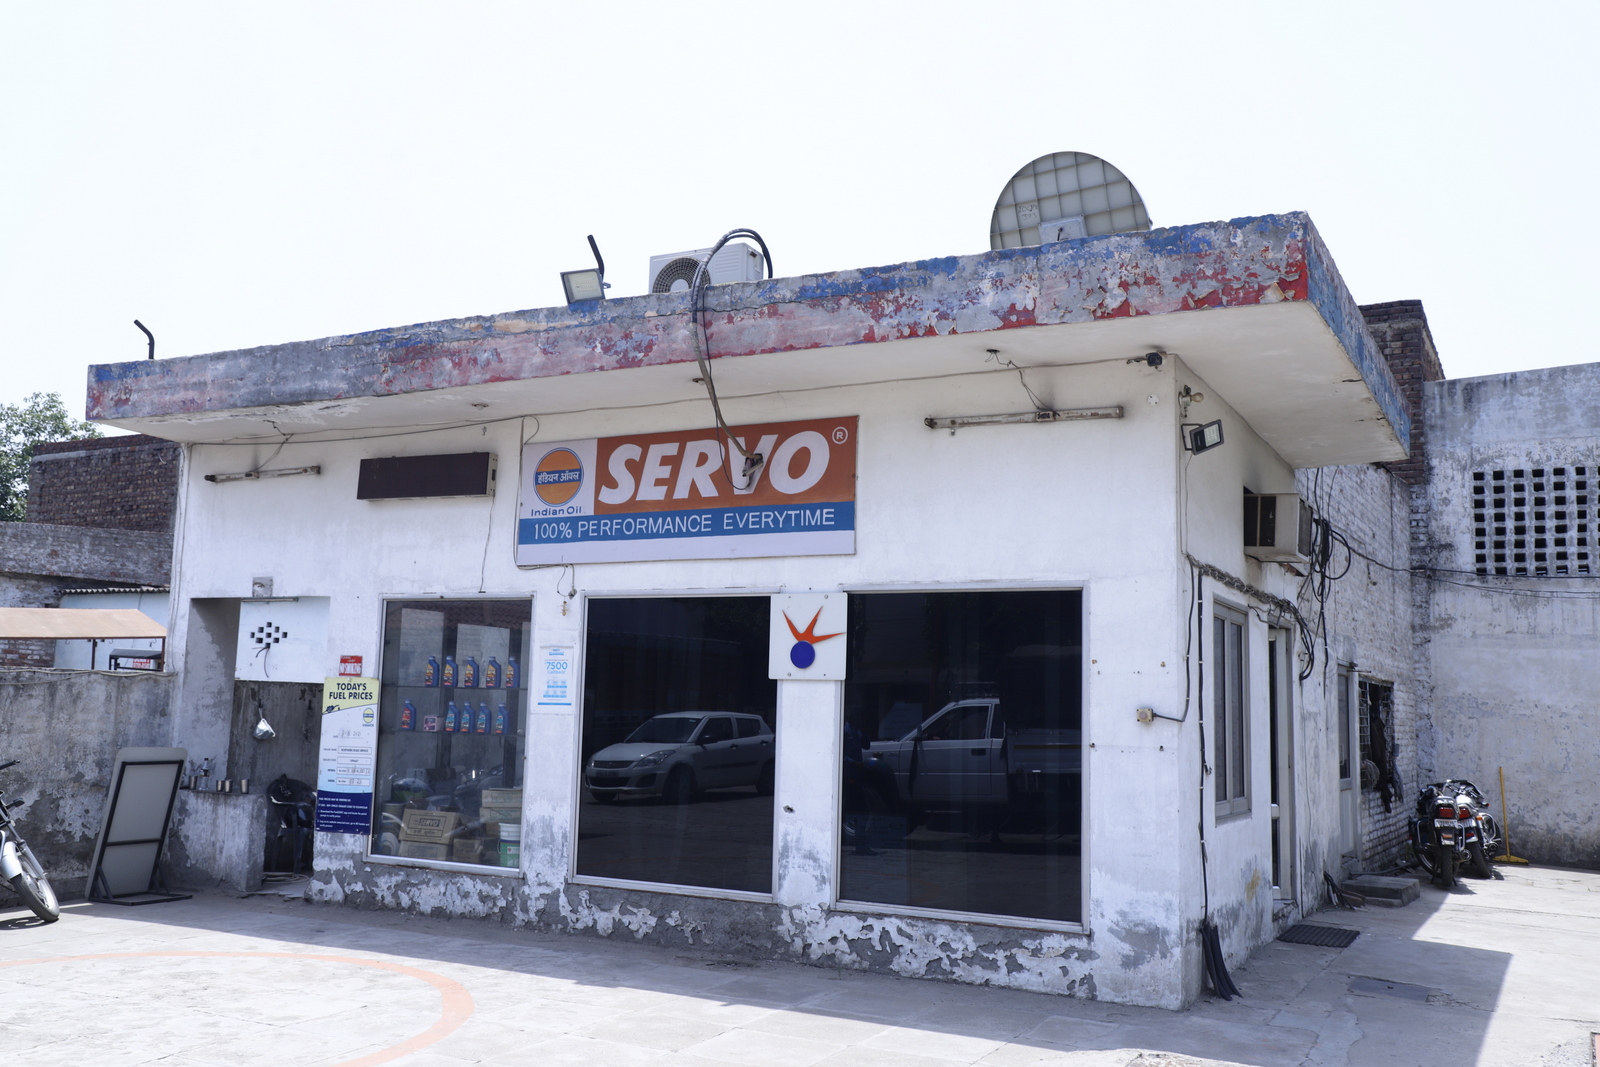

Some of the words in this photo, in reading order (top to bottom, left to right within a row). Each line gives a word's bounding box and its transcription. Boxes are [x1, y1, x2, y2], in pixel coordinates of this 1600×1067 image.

[598, 430, 830, 505] SERVO
[537, 472, 559, 484] इंडियन
[534, 521, 573, 540] 100%
[578, 514, 712, 538] PERFORMANCE
[723, 508, 835, 530] EVERYTIME
[546, 661, 568, 670] 7500
[336, 682, 367, 691] TODAY'S
[328, 691, 346, 700] FUEL
[348, 691, 373, 700] PRICES
